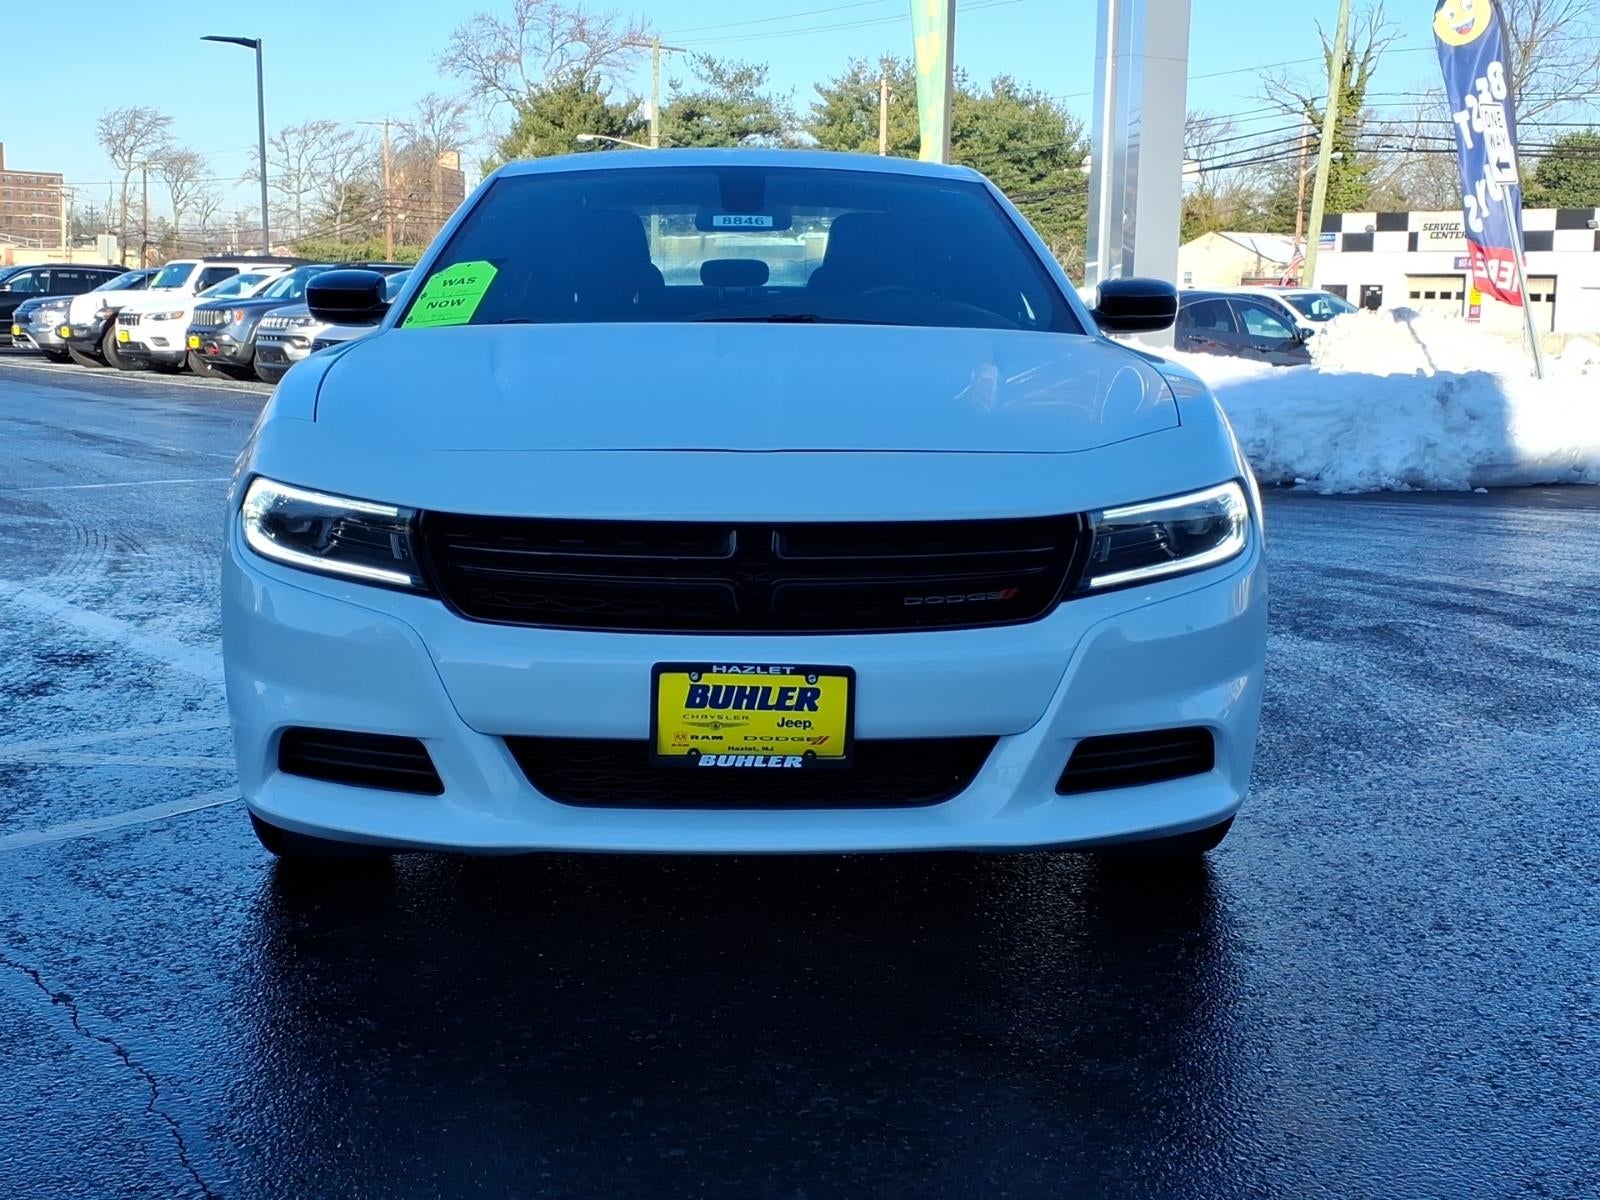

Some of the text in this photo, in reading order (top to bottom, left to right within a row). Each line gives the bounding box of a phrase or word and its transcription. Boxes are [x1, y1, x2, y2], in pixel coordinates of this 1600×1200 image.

[1484, 111, 1503, 128] ONE
[1489, 134, 1507, 150] WAY
[722, 216, 765, 225] 8846
[1422, 223, 1461, 231] SERVICE
[1430, 231, 1468, 239] CENTER
[442, 277, 477, 287] WAS
[426, 298, 466, 309] NOW
[904, 592, 1004, 605] DODGE
[712, 665, 795, 675] HAZLET
[685, 684, 821, 712] BUHLER
[682, 713, 749, 721] CHRYSLER
[777, 717, 812, 730] Jeep
[699, 754, 803, 768] BUHLER
